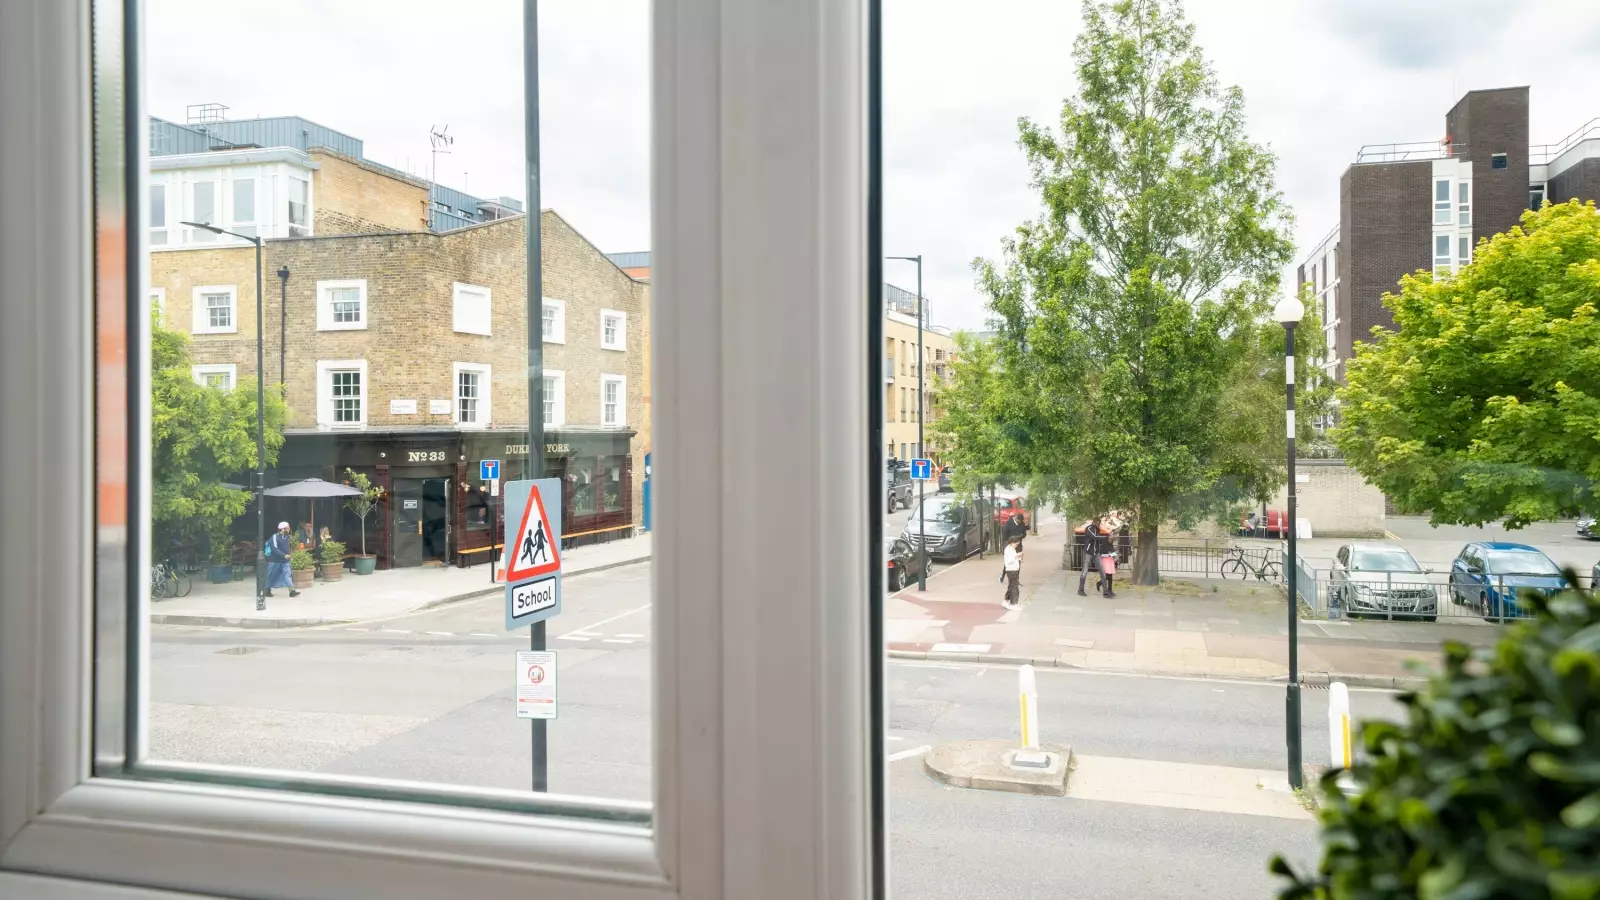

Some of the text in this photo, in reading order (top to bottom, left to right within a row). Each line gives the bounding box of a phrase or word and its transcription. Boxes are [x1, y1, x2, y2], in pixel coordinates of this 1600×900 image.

[546, 443, 570, 453] YORK
[429, 451, 446, 462] 33
[517, 585, 552, 609] School
